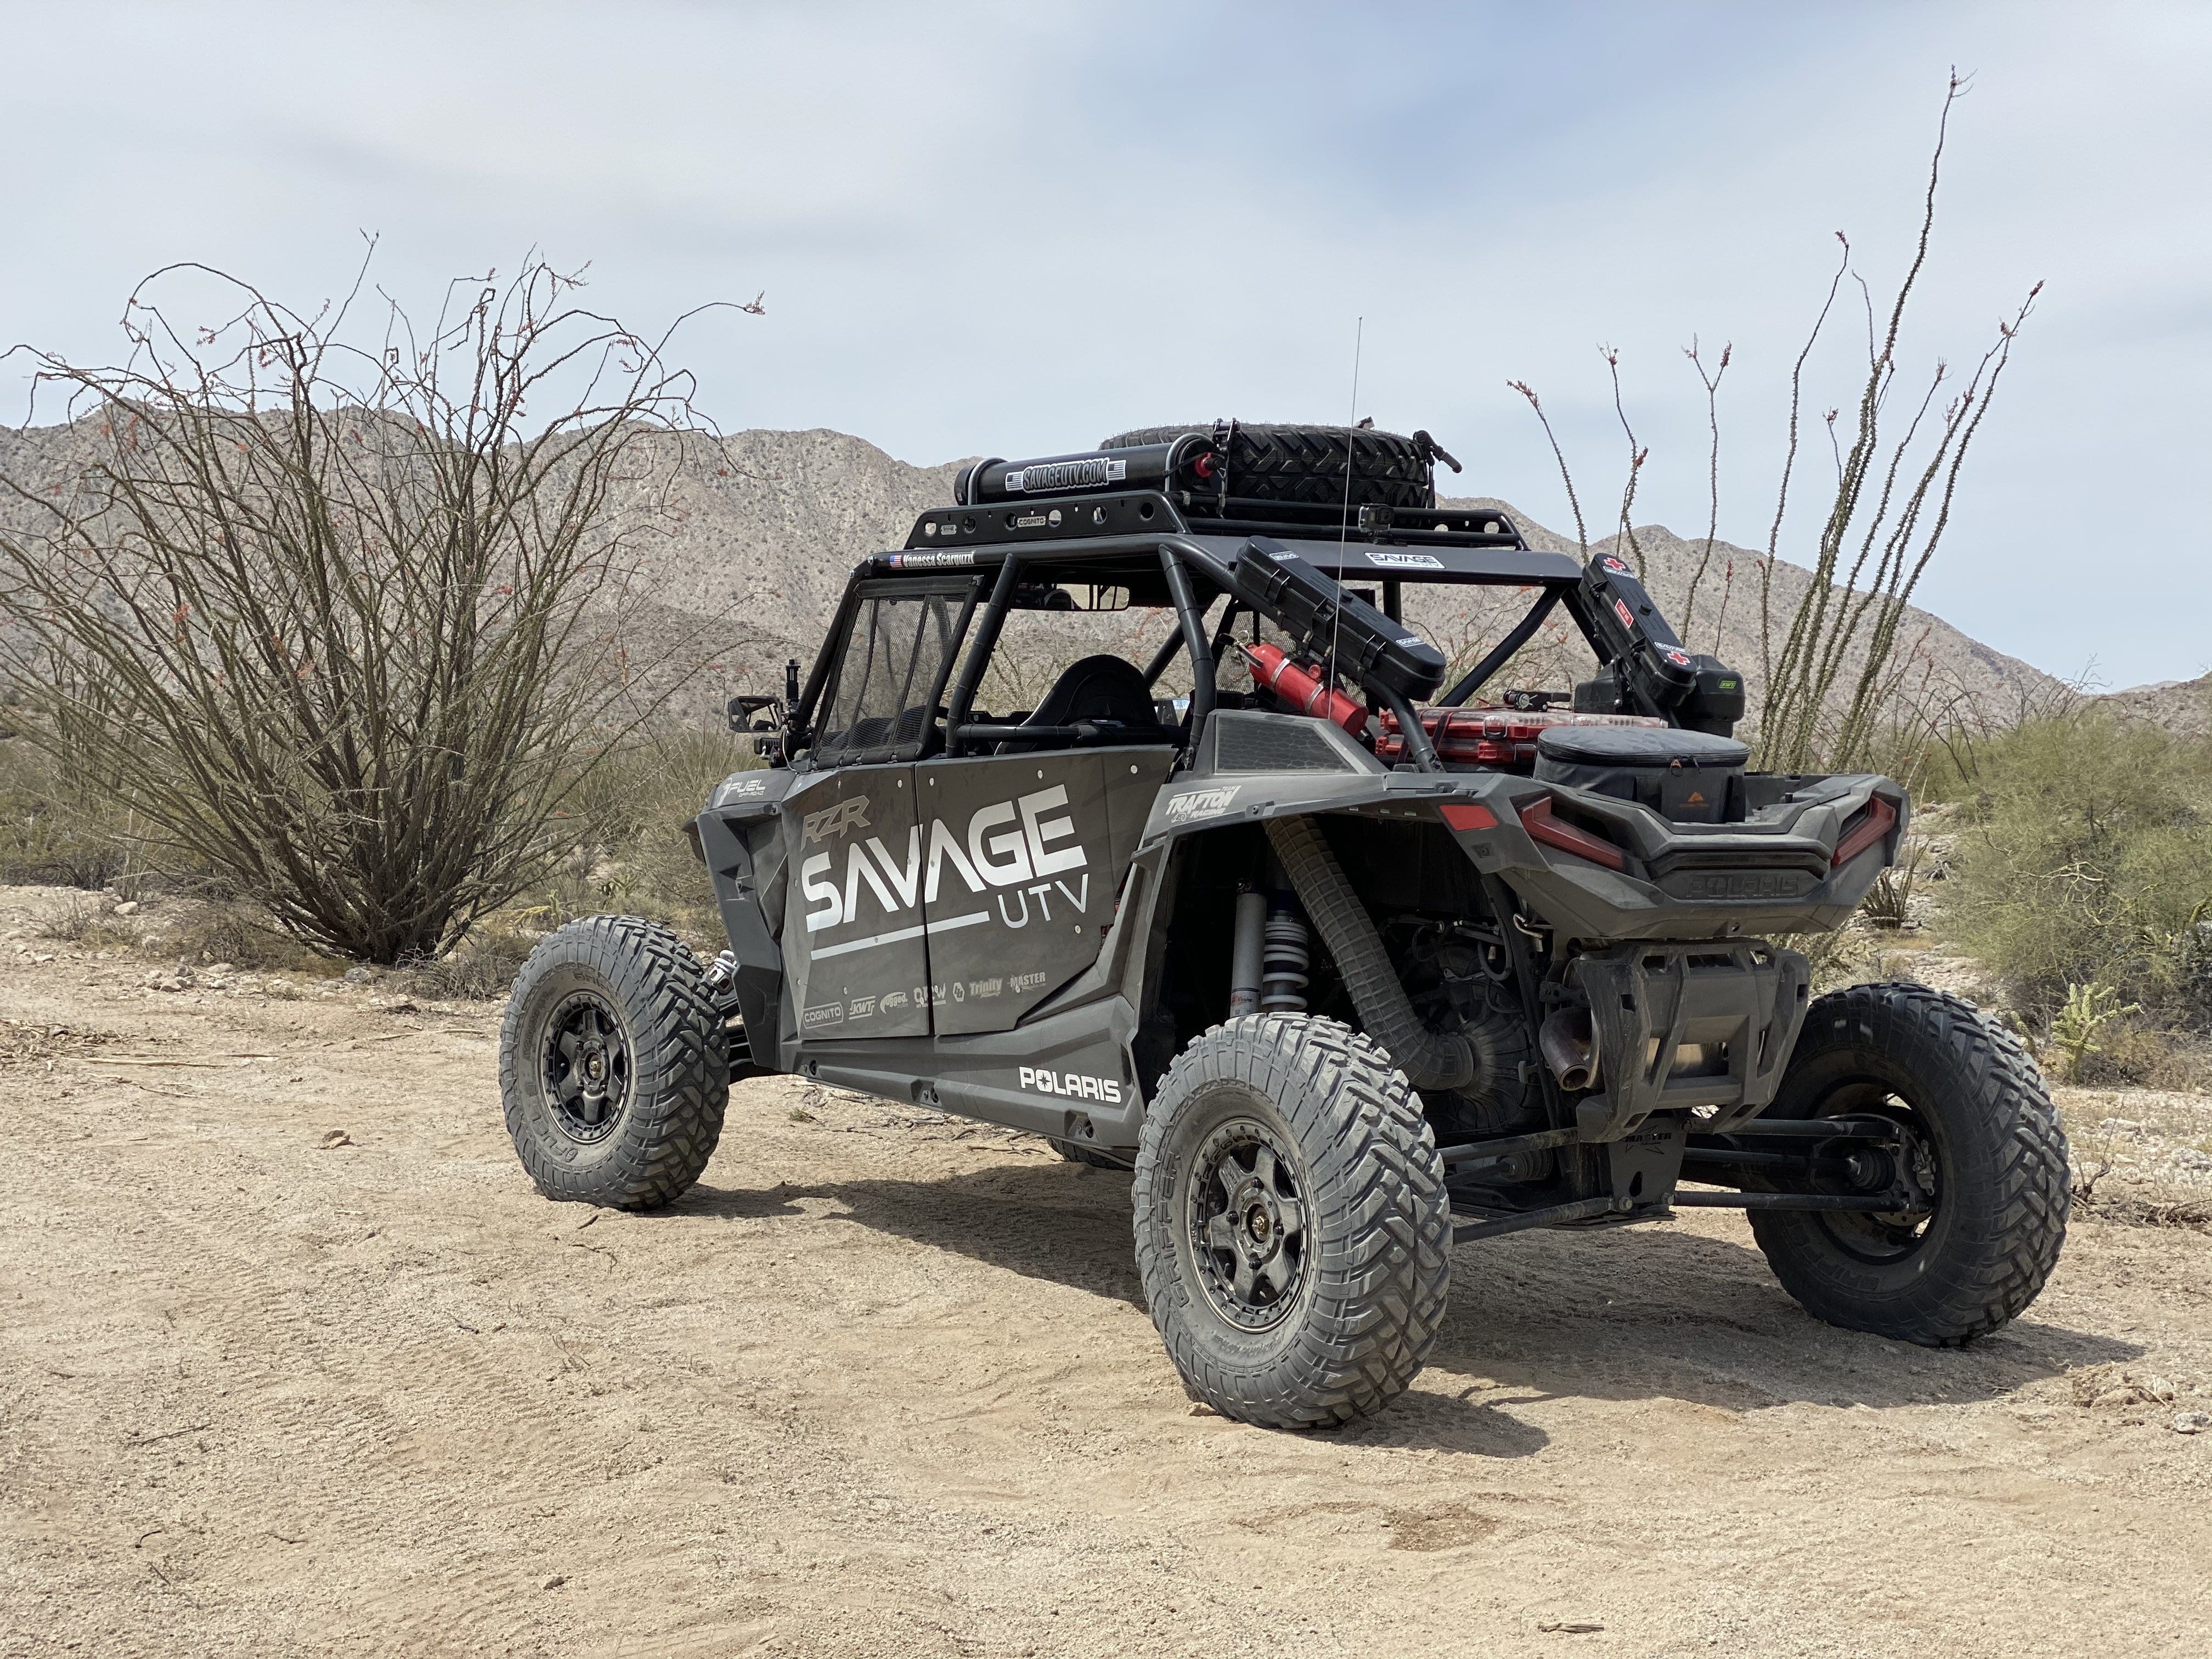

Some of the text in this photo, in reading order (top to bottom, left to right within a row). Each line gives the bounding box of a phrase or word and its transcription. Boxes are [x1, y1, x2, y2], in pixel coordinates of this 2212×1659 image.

[1022, 459, 1109, 492] SAVAGEUTV.COM
[904, 554, 936, 567] Vanessa
[1369, 554, 1437, 563] SAVAGE
[727, 779, 765, 794] FUEL
[1165, 785, 1242, 816] TRAFTON
[800, 794, 871, 852] RZR
[1189, 808, 1226, 818] RACING
[802, 784, 1087, 932] SAVAGE
[997, 873, 1088, 929] UTV
[1010, 972, 1046, 988] MASTER
[804, 1007, 841, 1023] COGNITO
[1019, 1066, 1121, 1104] POLARIS
[1157, 1151, 1190, 1308] GRIPPER
